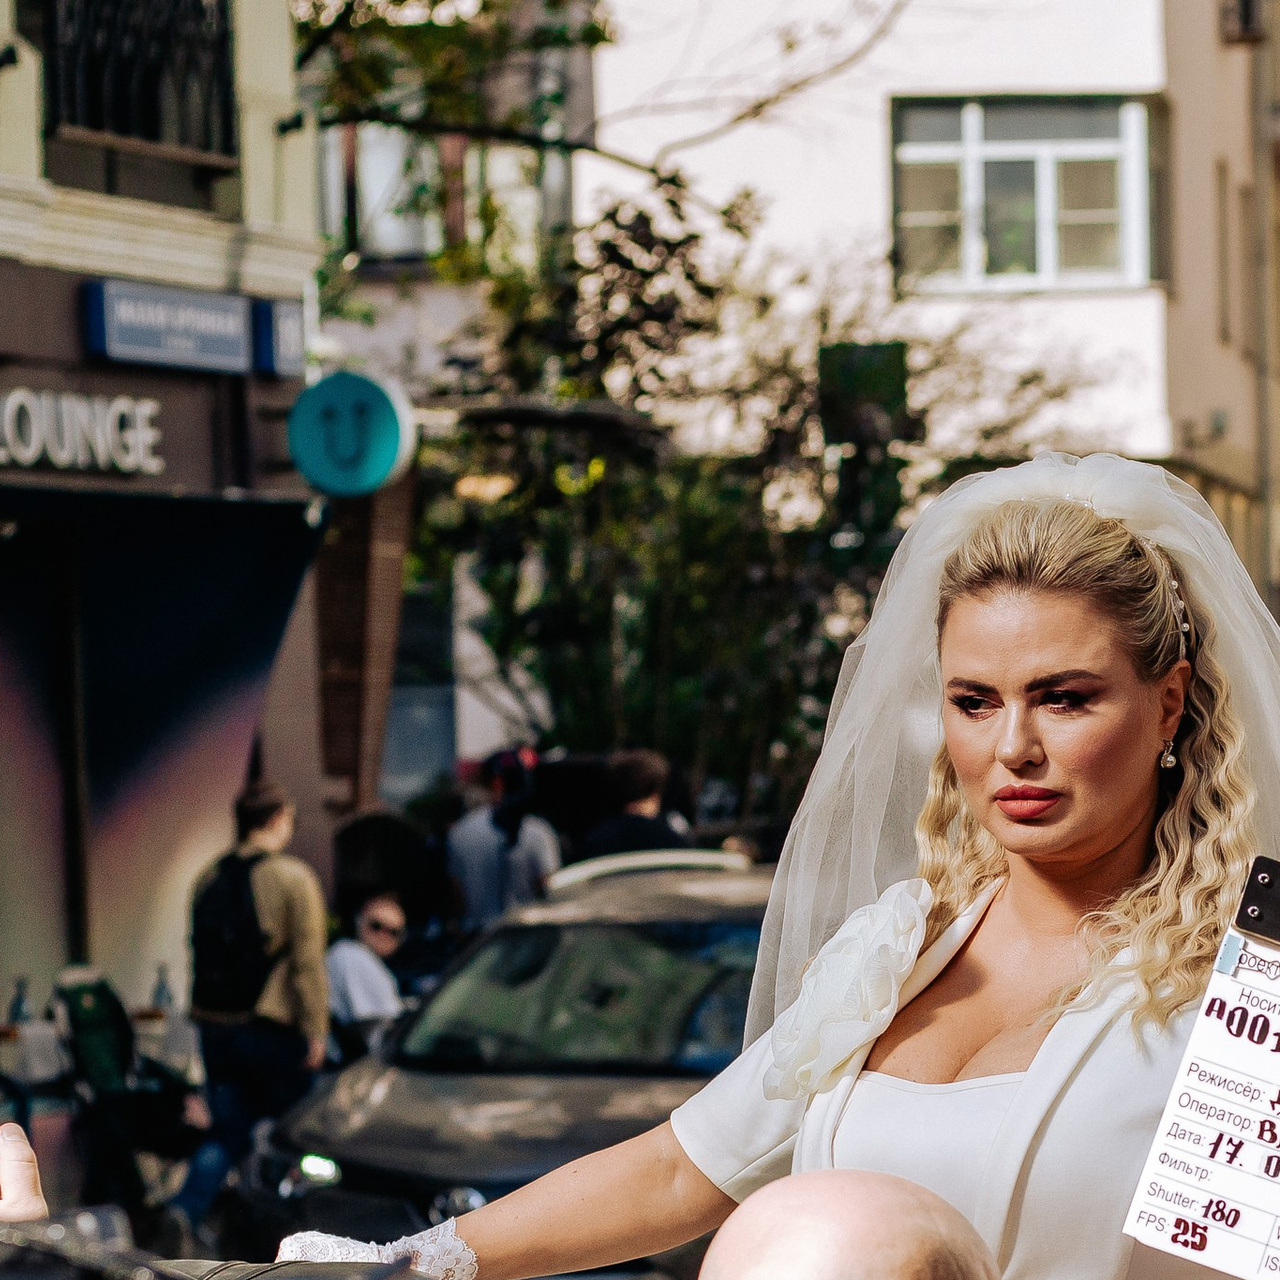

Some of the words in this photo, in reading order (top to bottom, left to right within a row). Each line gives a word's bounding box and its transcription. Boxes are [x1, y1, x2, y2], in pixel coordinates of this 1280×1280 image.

[0, 387, 166, 476] OUNGE
[1186, 1062, 1266, 1103] Режиссёр:
[1178, 1092, 1254, 1132] Оператор:
[1167, 1122, 1205, 1147] Дата:
[1158, 1151, 1213, 1182] Фильтр:
[1147, 1182, 1200, 1211] Shutter:
[1201, 1198, 1241, 1228] 180
[1136, 1210, 1168, 1234] FPS:
[1170, 1217, 1209, 1252] 25
